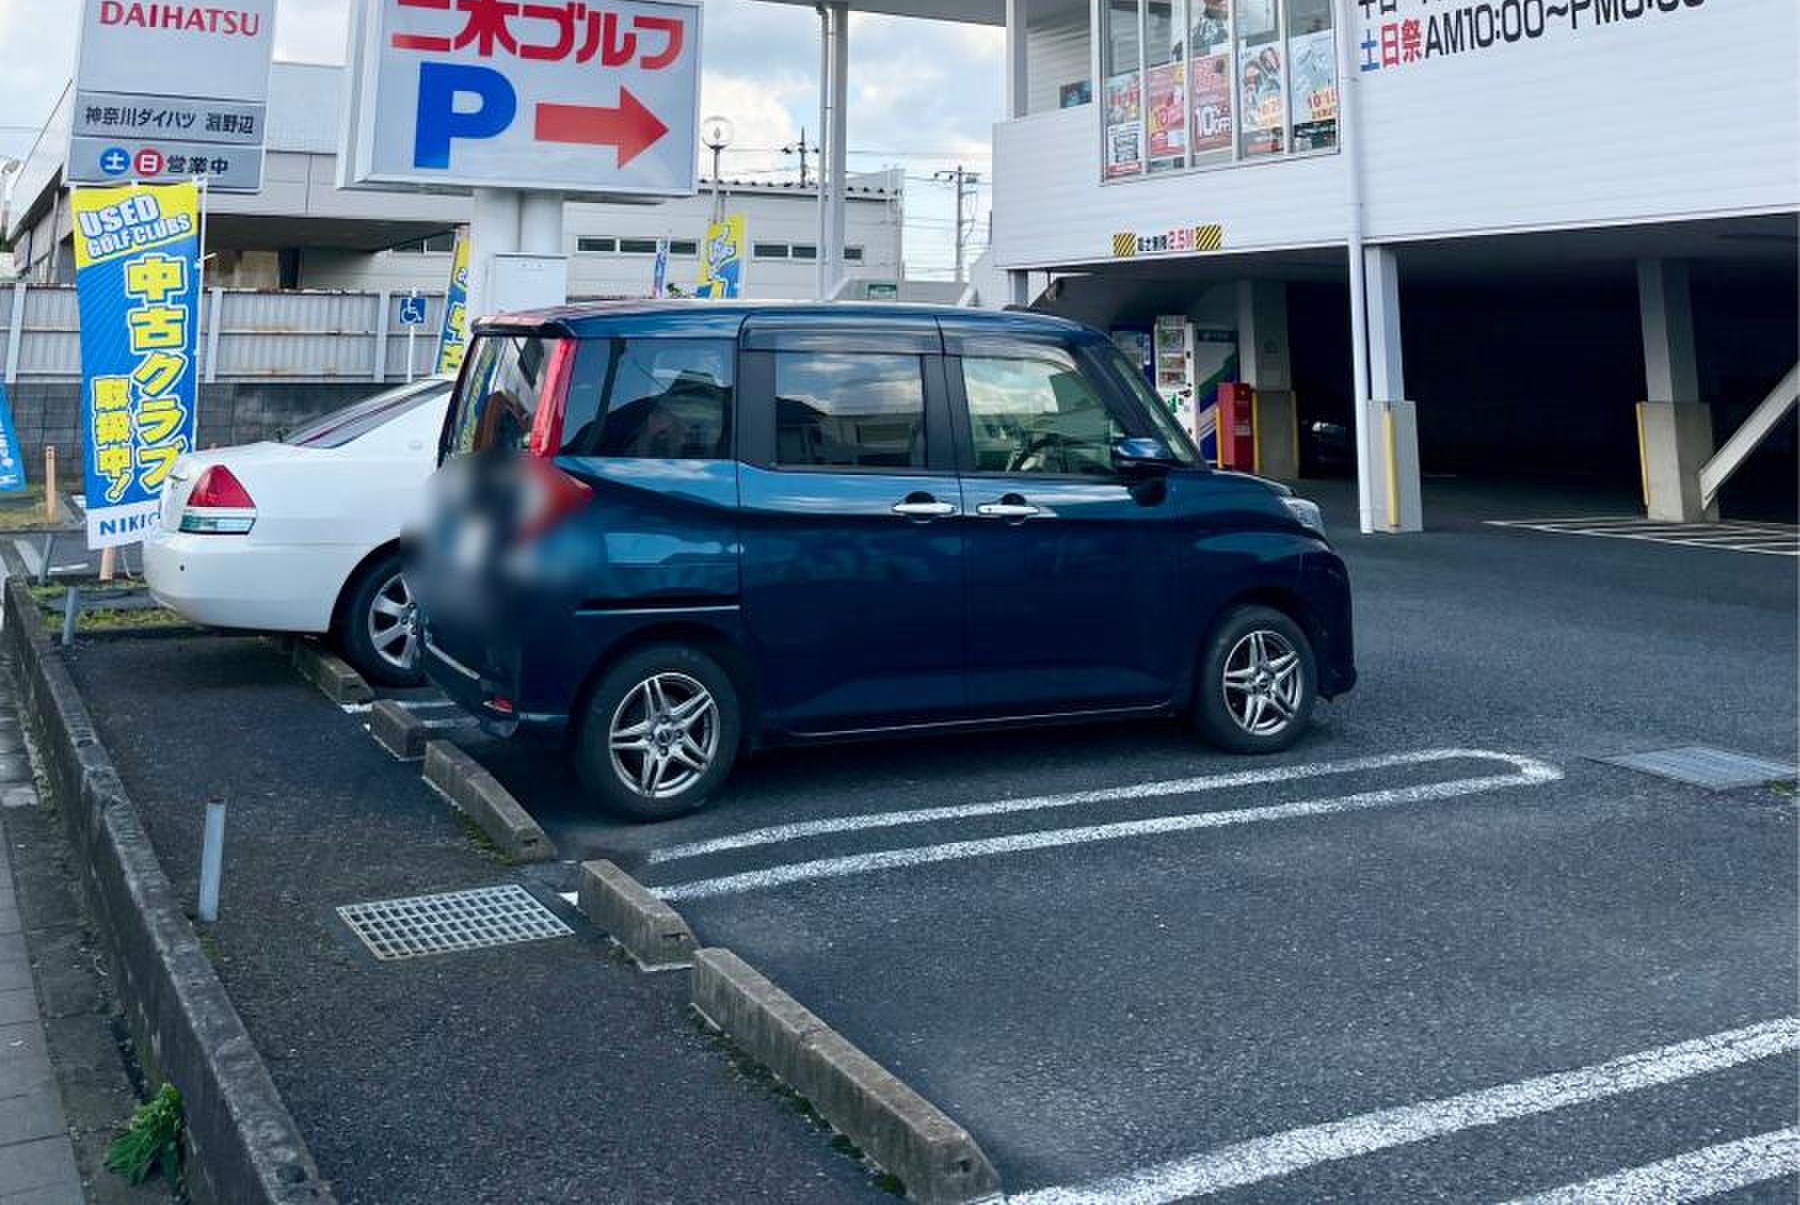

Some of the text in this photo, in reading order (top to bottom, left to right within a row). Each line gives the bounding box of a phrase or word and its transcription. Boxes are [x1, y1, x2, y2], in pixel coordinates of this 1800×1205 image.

[99, 0, 260, 37] DAIHATSU
[86, 106, 196, 130] 神奈川ダイハツ
[414, 61, 517, 169] P
[79, 194, 159, 237] USED
[87, 214, 192, 259] GOLF CLUBS
[126, 255, 188, 492] 中古クラブ
